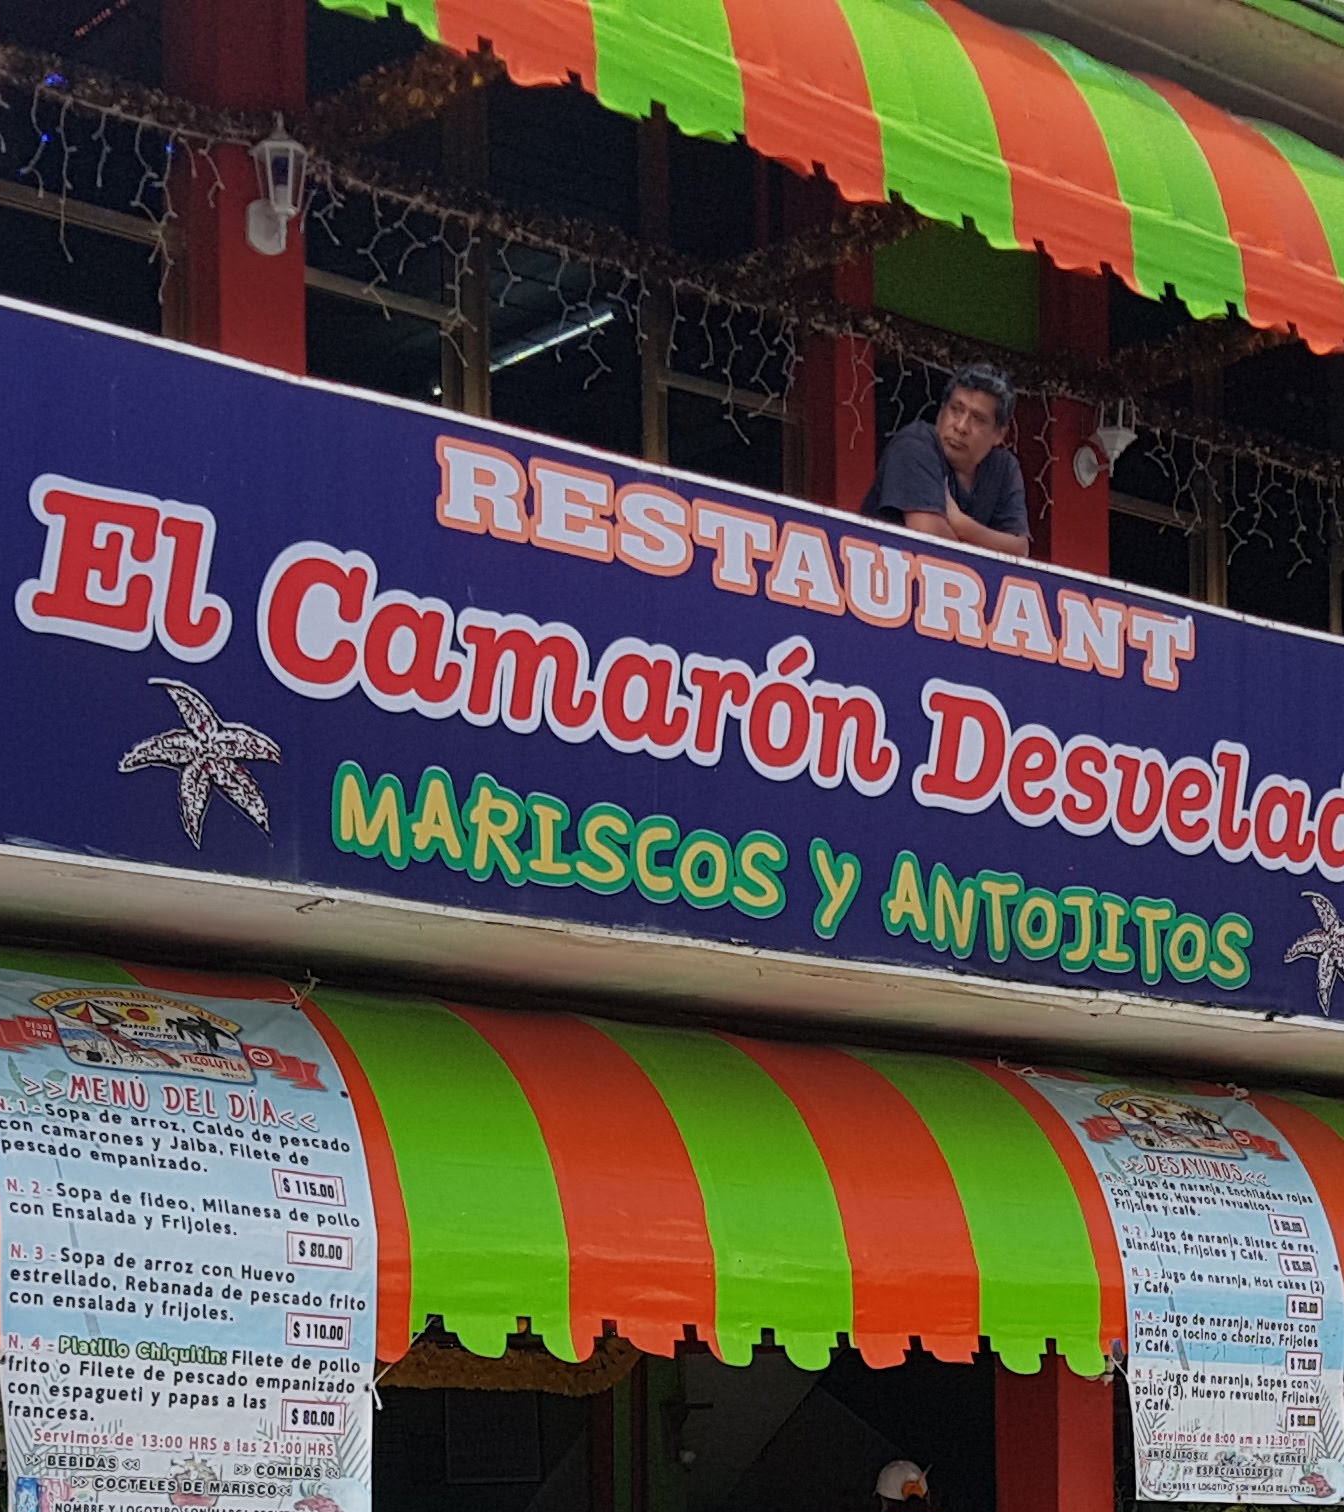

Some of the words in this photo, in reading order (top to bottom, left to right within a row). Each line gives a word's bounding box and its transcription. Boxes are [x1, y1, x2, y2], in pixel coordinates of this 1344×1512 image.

[436, 435, 1196, 690] RESTAURANT
[30, 487, 222, 650] El
[263, 552, 895, 786] Camarón
[337, 770, 783, 910] MARISCOS
[887, 858, 1248, 983] ANTOJITOS
[69, 1075, 146, 1110] MENÚ
[163, 1086, 216, 1118] DEL
[229, 1088, 277, 1123] DÍA
[41, 1120, 143, 1147] camarones
[153, 1136, 162, 1151] y
[230, 1142, 281, 1160] Filete
[289, 1148, 308, 1165] de
[45, 1104, 91, 1122] Sopa
[100, 1109, 121, 1125] de
[193, 1121, 244, 1140] Caldo
[252, 1125, 272, 1143] de
[280, 1132, 350, 1153] pescado
[1, 1139, 81, 1159] pescado
[90, 1149, 208, 1174] empanizado.
[1144, 1155, 1243, 1181] DESAYUNOS
[6, 1178, 24, 1193] N.
[56, 1182, 102, 1204] Sopa
[111, 1188, 131, 1204] de
[140, 1191, 194, 1213] fideo,
[203, 1198, 281, 1220] Milanesa
[289, 1206, 310, 1222] de
[317, 1211, 361, 1228] pollo
[310, 1241, 343, 1260] 80.00
[1192, 1314, 1205, 1325] de
[1256, 1319, 1294, 1332] Huevos
[1299, 1323, 1316, 1333] con
[9, 1335, 26, 1350] N.
[59, 1336, 129, 1358] Platillo
[233, 1350, 284, 1369] Filete
[291, 1354, 312, 1370] de
[320, 1359, 360, 1375] pollo
[8, 1355, 50, 1374] frito
[60, 1362, 71, 1375] o
[80, 1361, 135, 1379] Filete
[144, 1365, 165, 1381] de
[176, 1370, 247, 1390] pescado
[256, 1375, 355, 1395] empanizado
[8, 1382, 42, 1396] con
[49, 1384, 143, 1405] espagueti
[151, 1390, 160, 1406] y
[168, 1390, 219, 1409] papas
[227, 1395, 236, 1407] a
[244, 1392, 267, 1410] las
[8, 1400, 95, 1422] francesa.
[303, 1410, 335, 1427] 80.00
[34, 1428, 108, 1446] Servimos
[115, 1430, 133, 1446] de
[141, 1432, 183, 1449] 13:00
[189, 1435, 217, 1451] HRS
[223, 1442, 231, 1452] a
[237, 1438, 256, 1454] las
[262, 1439, 301, 1455] 21:00
[307, 1441, 333, 1457] HRS
[1200, 1433, 1211, 1443] de
[48, 1456, 117, 1470] BEBIDAS
[256, 1464, 321, 1479] COMIDAS
[95, 1478, 177, 1493] COCTELES
[183, 1481, 203, 1494] DE
[210, 1482, 276, 1497] MARISCO
